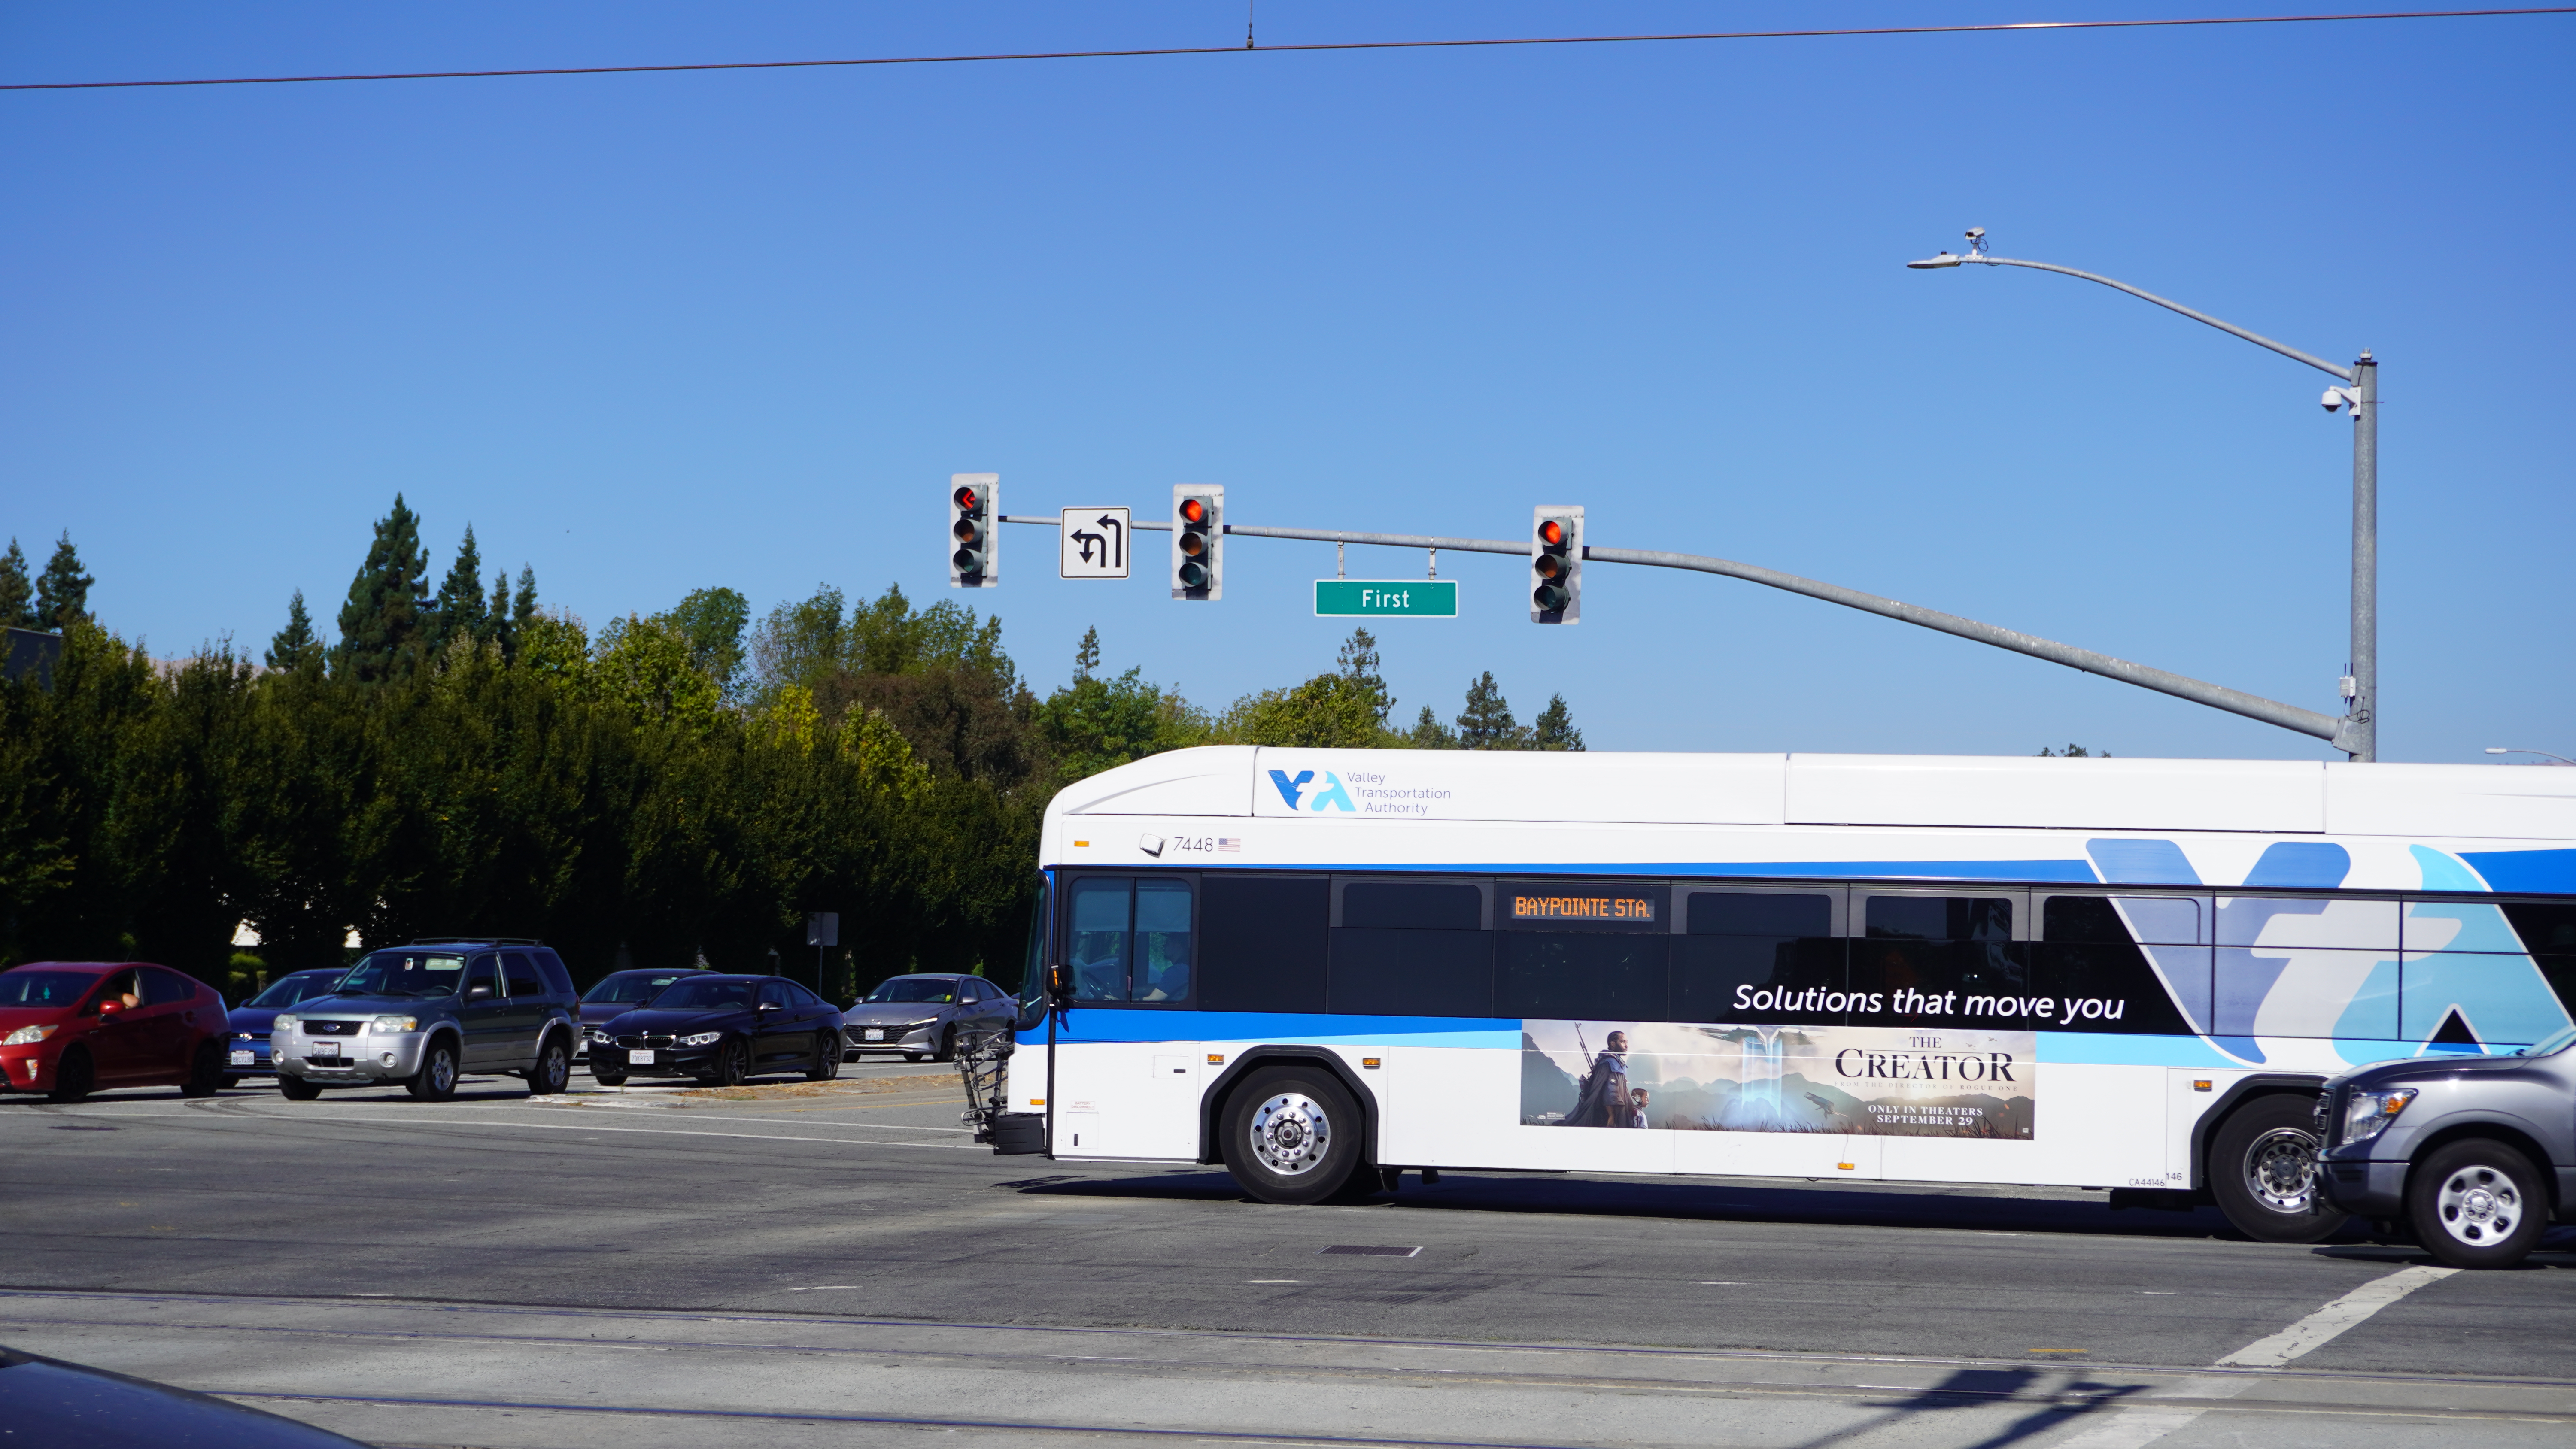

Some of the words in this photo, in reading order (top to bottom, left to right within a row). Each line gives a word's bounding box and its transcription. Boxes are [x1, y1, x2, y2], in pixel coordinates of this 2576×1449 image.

[1362, 589, 1410, 608] First
[1347, 772, 1385, 785] Valley
[1355, 787, 1451, 800] Transportation
[1365, 802, 1428, 816] Authority
[1173, 837, 1213, 852] 7448
[1516, 897, 1609, 917] BAYPOINTE
[1615, 899, 1650, 917] STA.
[1733, 984, 1883, 1013] Solutions
[1893, 987, 1956, 1015] that
[1964, 995, 2054, 1018] move
[2059, 997, 2125, 1025] you
[1909, 1036, 1941, 1048] THE
[1835, 1048, 2017, 1082] CREATOR
[1868, 1105, 1899, 1113] ONLY
[1920, 1106, 1983, 1116] THEATERS
[1877, 1114, 1953, 1125] SEPTEMBER
[1958, 1117, 1974, 1125] 29
[2129, 1178, 2165, 1186] CA44146
